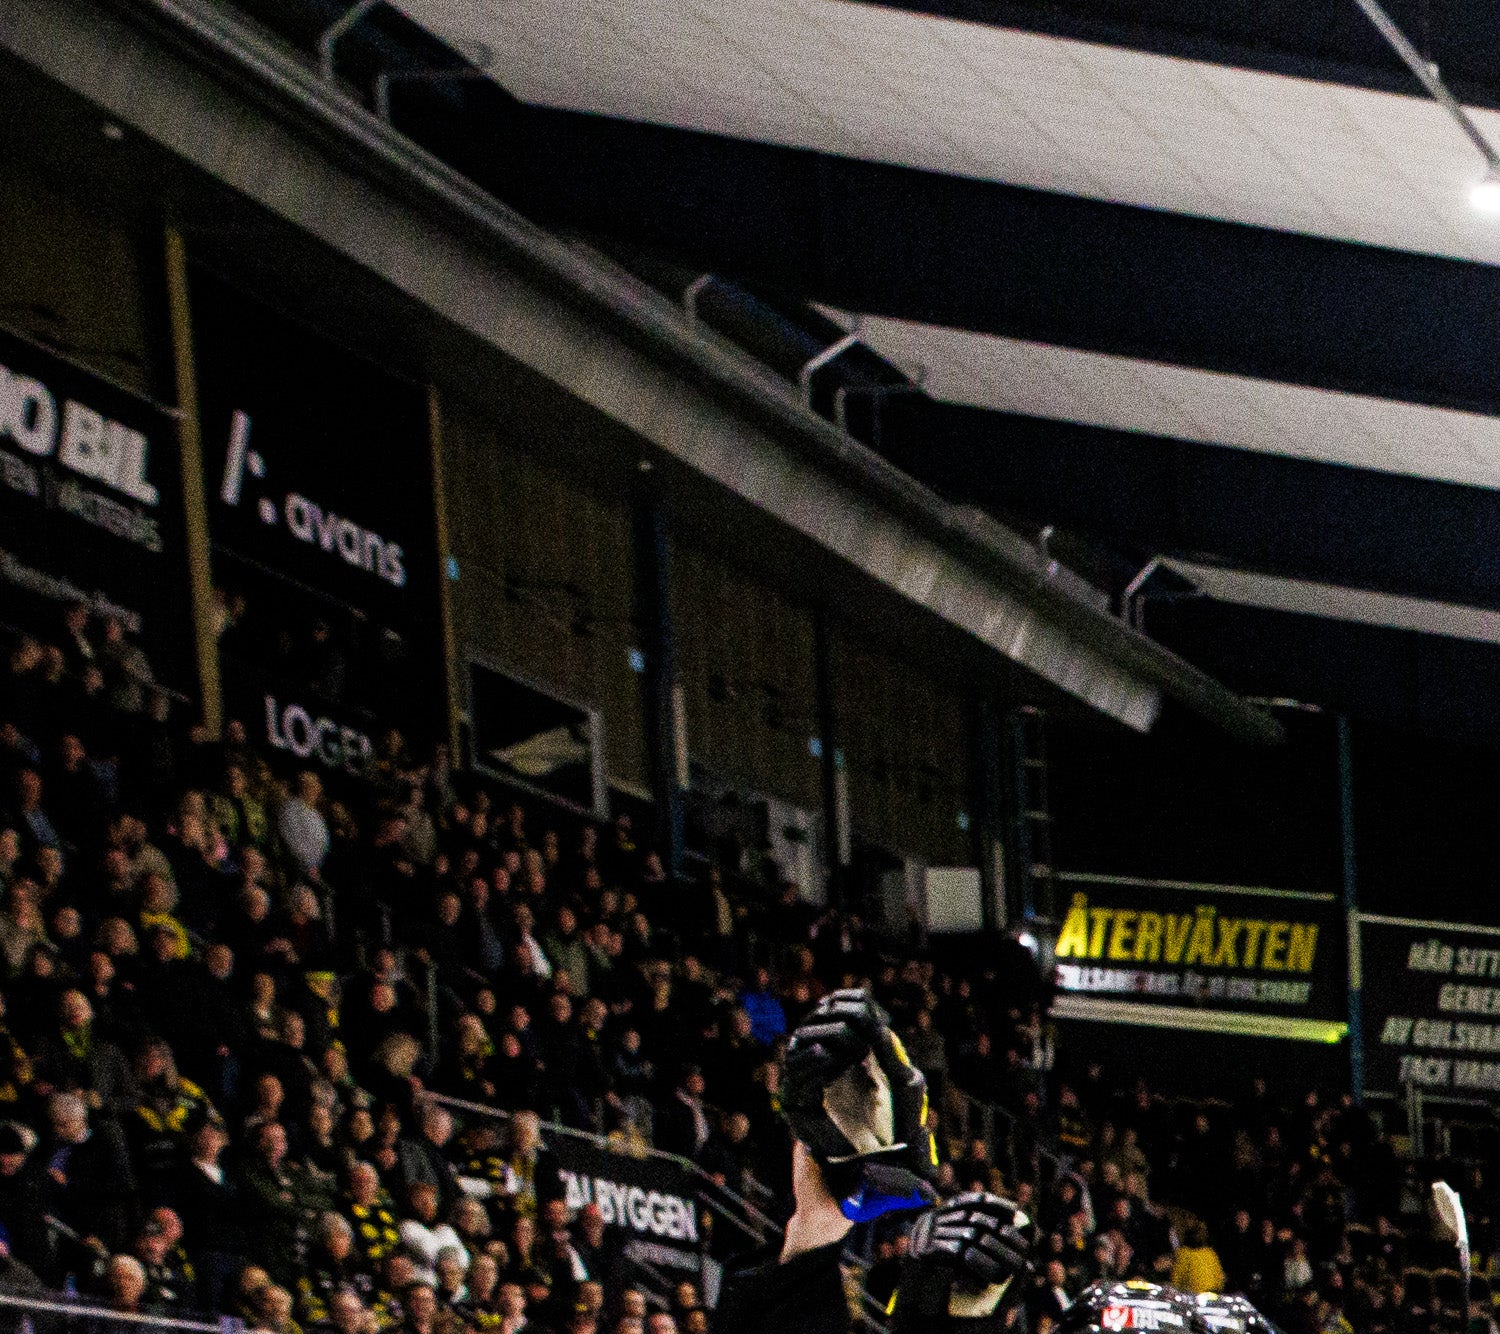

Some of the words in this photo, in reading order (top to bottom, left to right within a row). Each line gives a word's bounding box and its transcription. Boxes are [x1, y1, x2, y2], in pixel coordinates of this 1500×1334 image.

[59, 399, 158, 504] BIL
[285, 492, 406, 587] avans
[1053, 891, 1320, 974] ÅTERVÄXTEN
